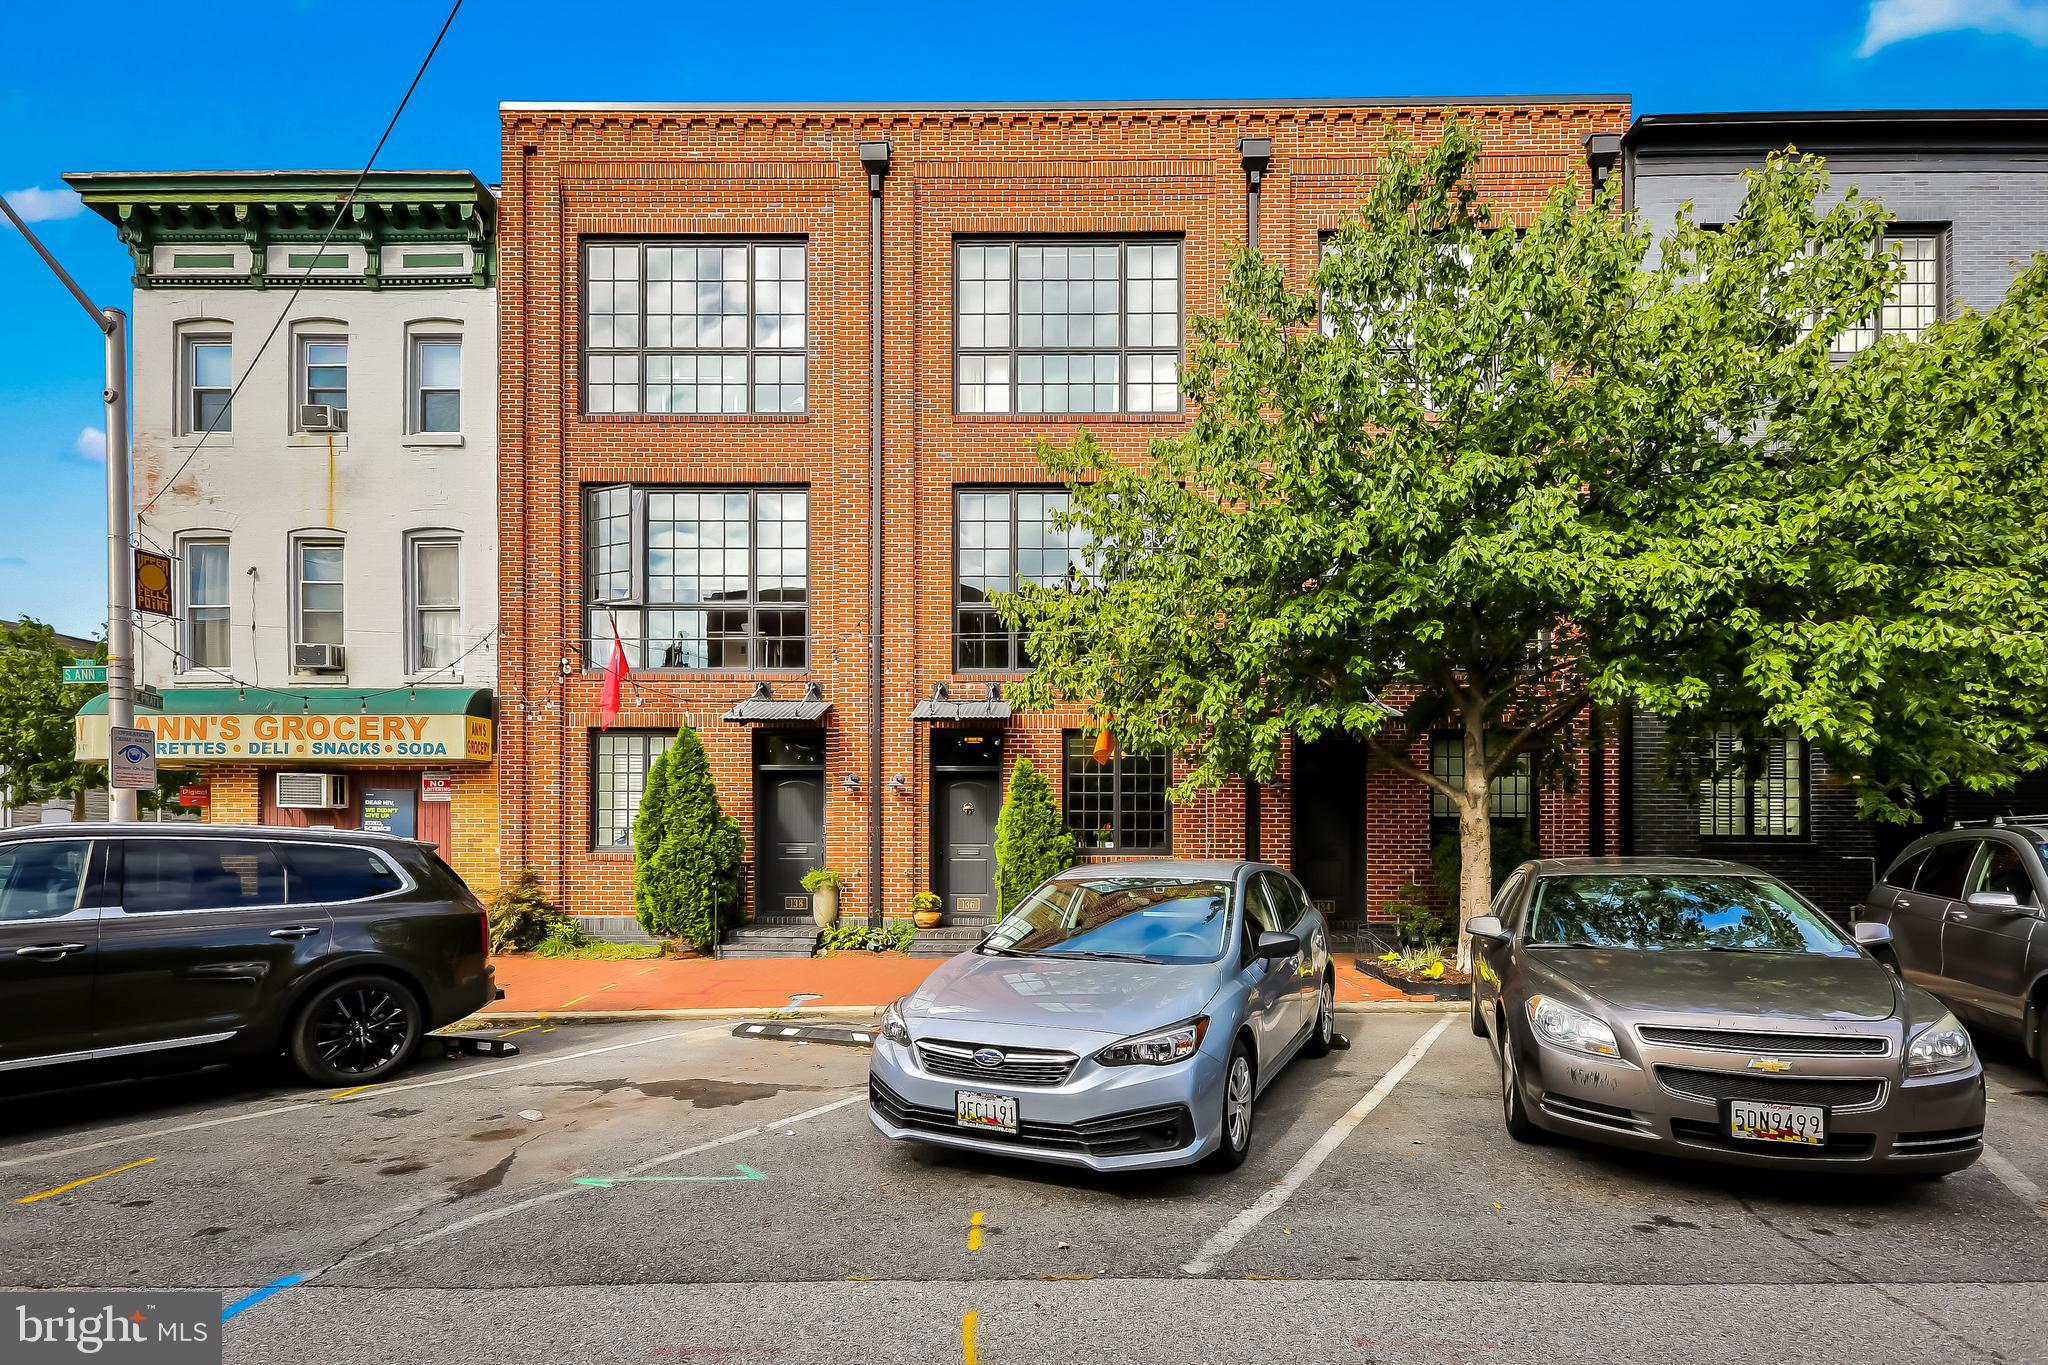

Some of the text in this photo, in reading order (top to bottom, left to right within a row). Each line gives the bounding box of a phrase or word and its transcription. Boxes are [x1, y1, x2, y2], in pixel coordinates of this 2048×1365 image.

[137, 553, 169, 576] UPPER
[137, 579, 169, 601] FELLS
[74, 669, 96, 681] ANN
[134, 715, 430, 741] ANN'S GROCERY
[471, 721, 487, 737] ANN'S
[156, 742, 447, 755] RETTES DELI SNACKS SODA
[467, 739, 490, 756] GROCERY
[790, 899, 804, 908] 138
[962, 900, 975, 909] 136
[1761, 1103, 1792, 1111] Maryland
[1735, 1108, 1820, 1137] 5DN9499
